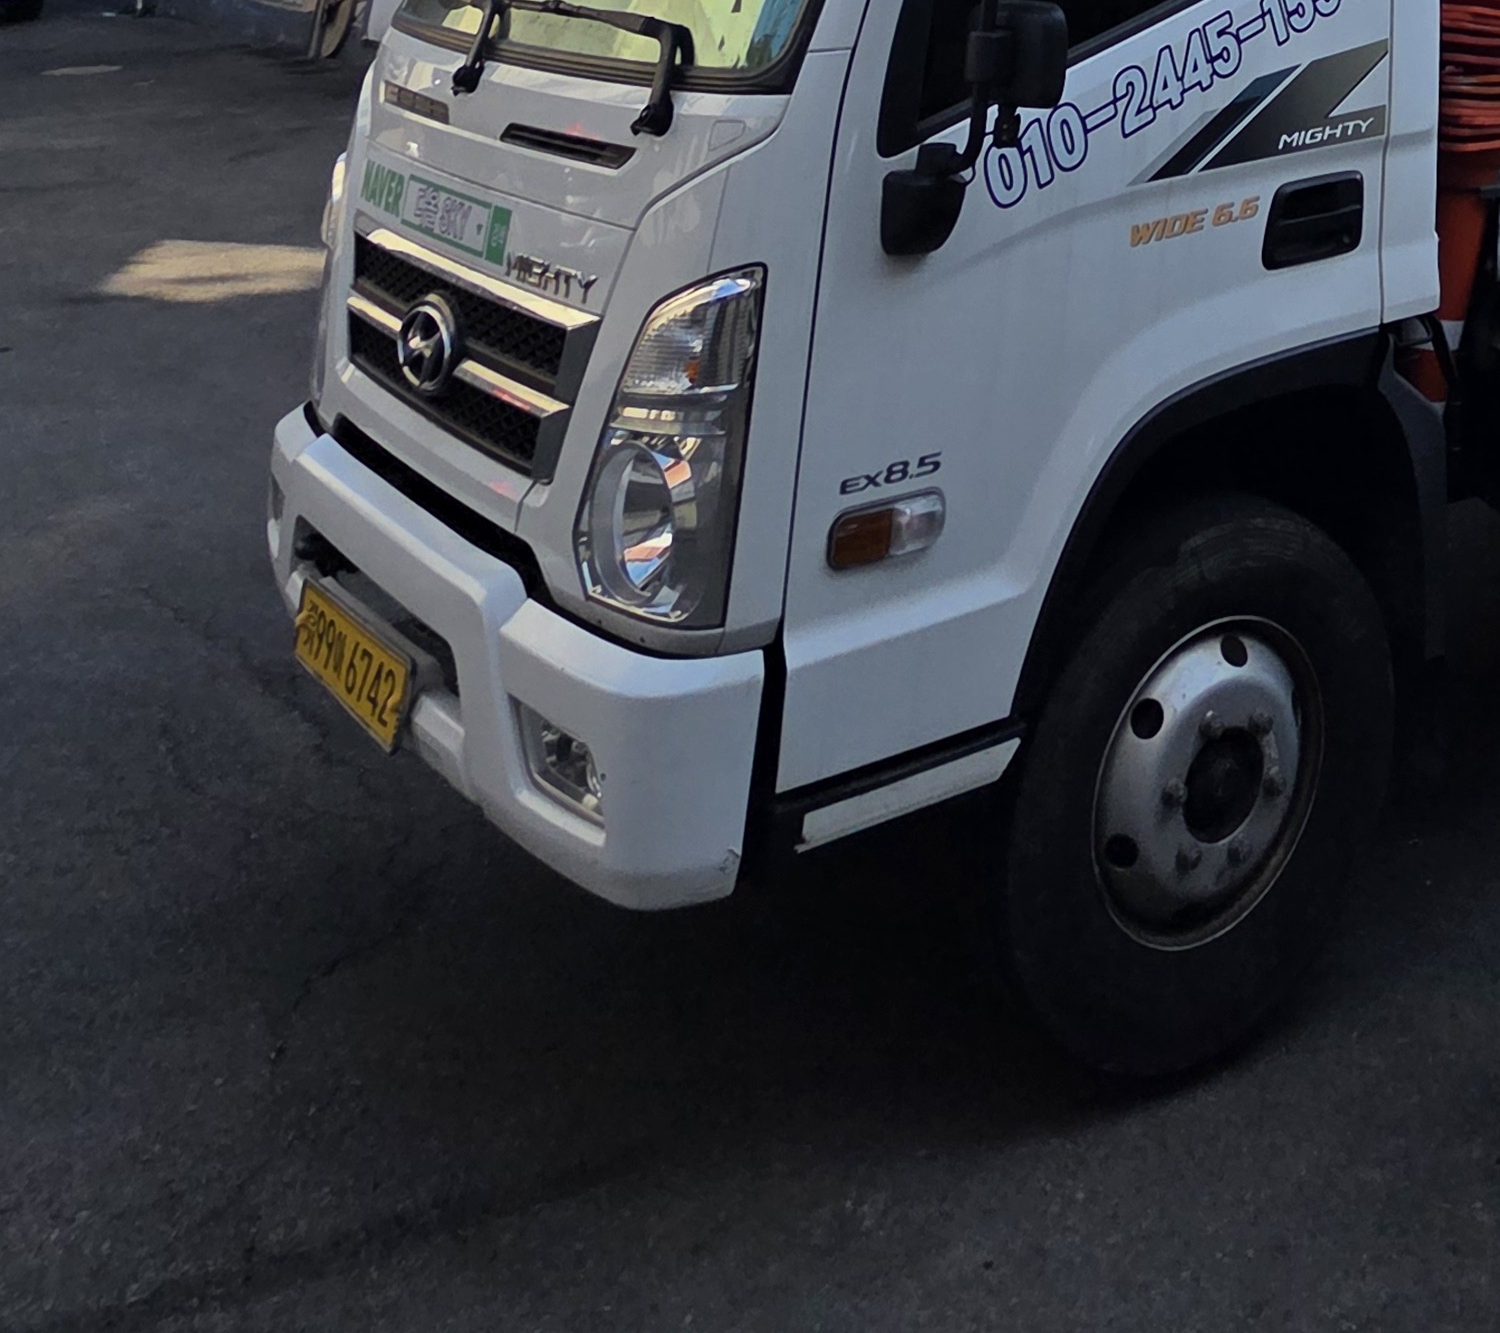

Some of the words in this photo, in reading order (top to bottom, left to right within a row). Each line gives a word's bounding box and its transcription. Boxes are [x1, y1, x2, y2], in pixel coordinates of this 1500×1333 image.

[1278, 117, 1375, 150] MIGHTY
[360, 160, 405, 219] NAVER
[1130, 208, 1208, 247] WIDE
[1211, 195, 1260, 227] 6.6
[839, 451, 943, 496] EX8.5
[344, 641, 397, 728] 6742
